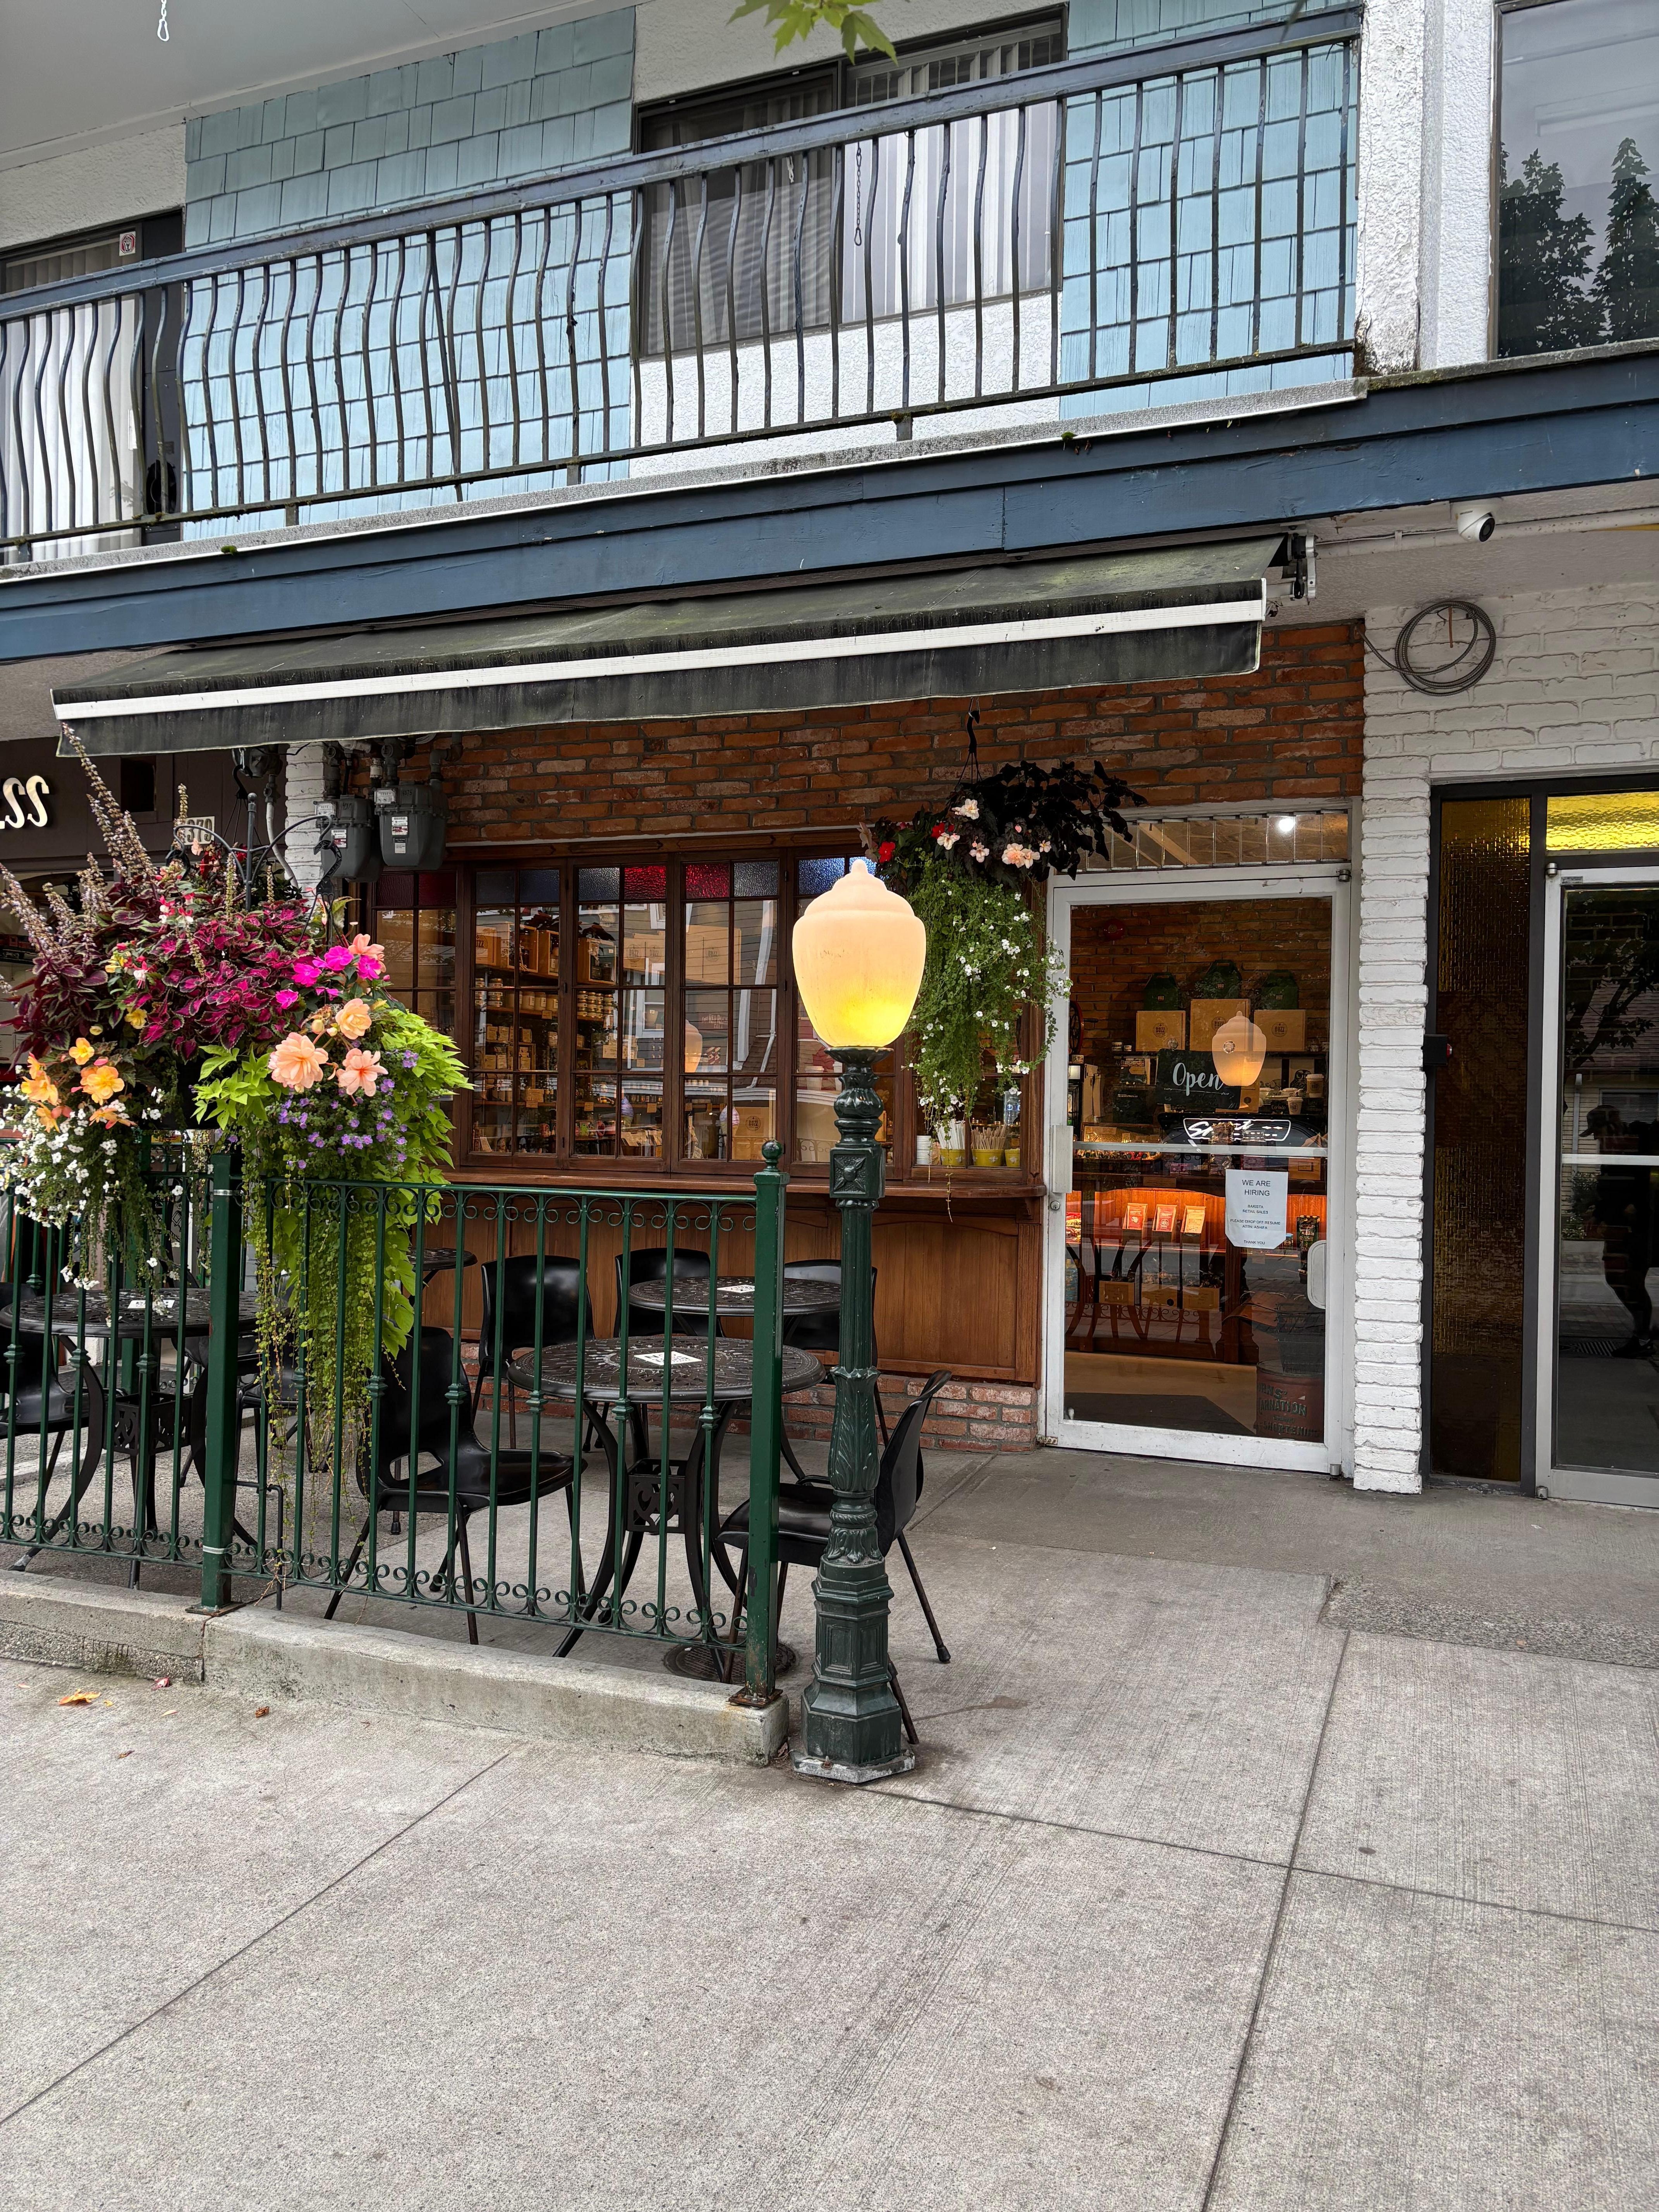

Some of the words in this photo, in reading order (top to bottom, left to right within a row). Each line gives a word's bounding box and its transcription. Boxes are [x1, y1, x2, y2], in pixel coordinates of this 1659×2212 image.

[0, 775, 50, 829] SS
[179, 818, 212, 843] 379
[1173, 1062, 1224, 1096] Open
